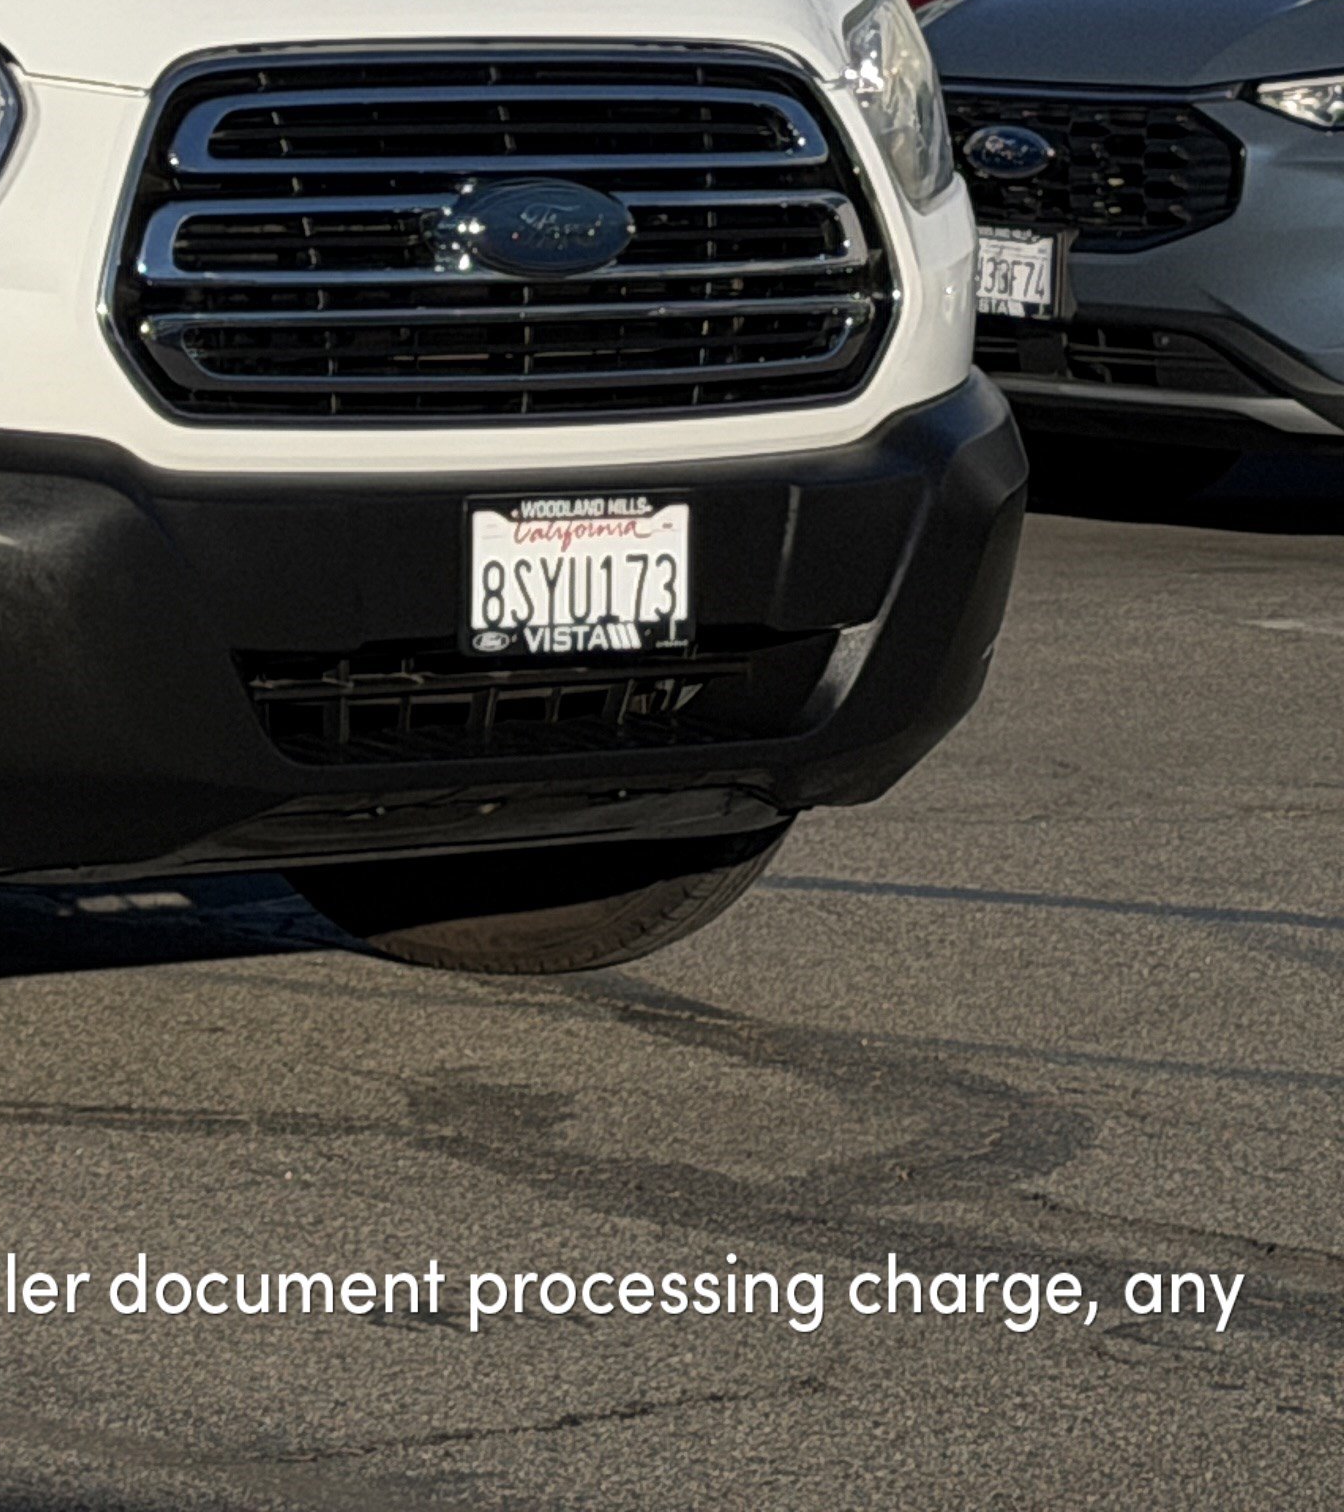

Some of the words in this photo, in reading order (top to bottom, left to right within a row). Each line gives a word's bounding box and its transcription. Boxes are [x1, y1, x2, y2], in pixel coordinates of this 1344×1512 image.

[520, 498, 605, 519] WOODLAND
[607, 496, 648, 516] HILLS
[513, 519, 653, 553] California
[481, 552, 678, 626] 8SYU173
[523, 625, 610, 654] VISTA
